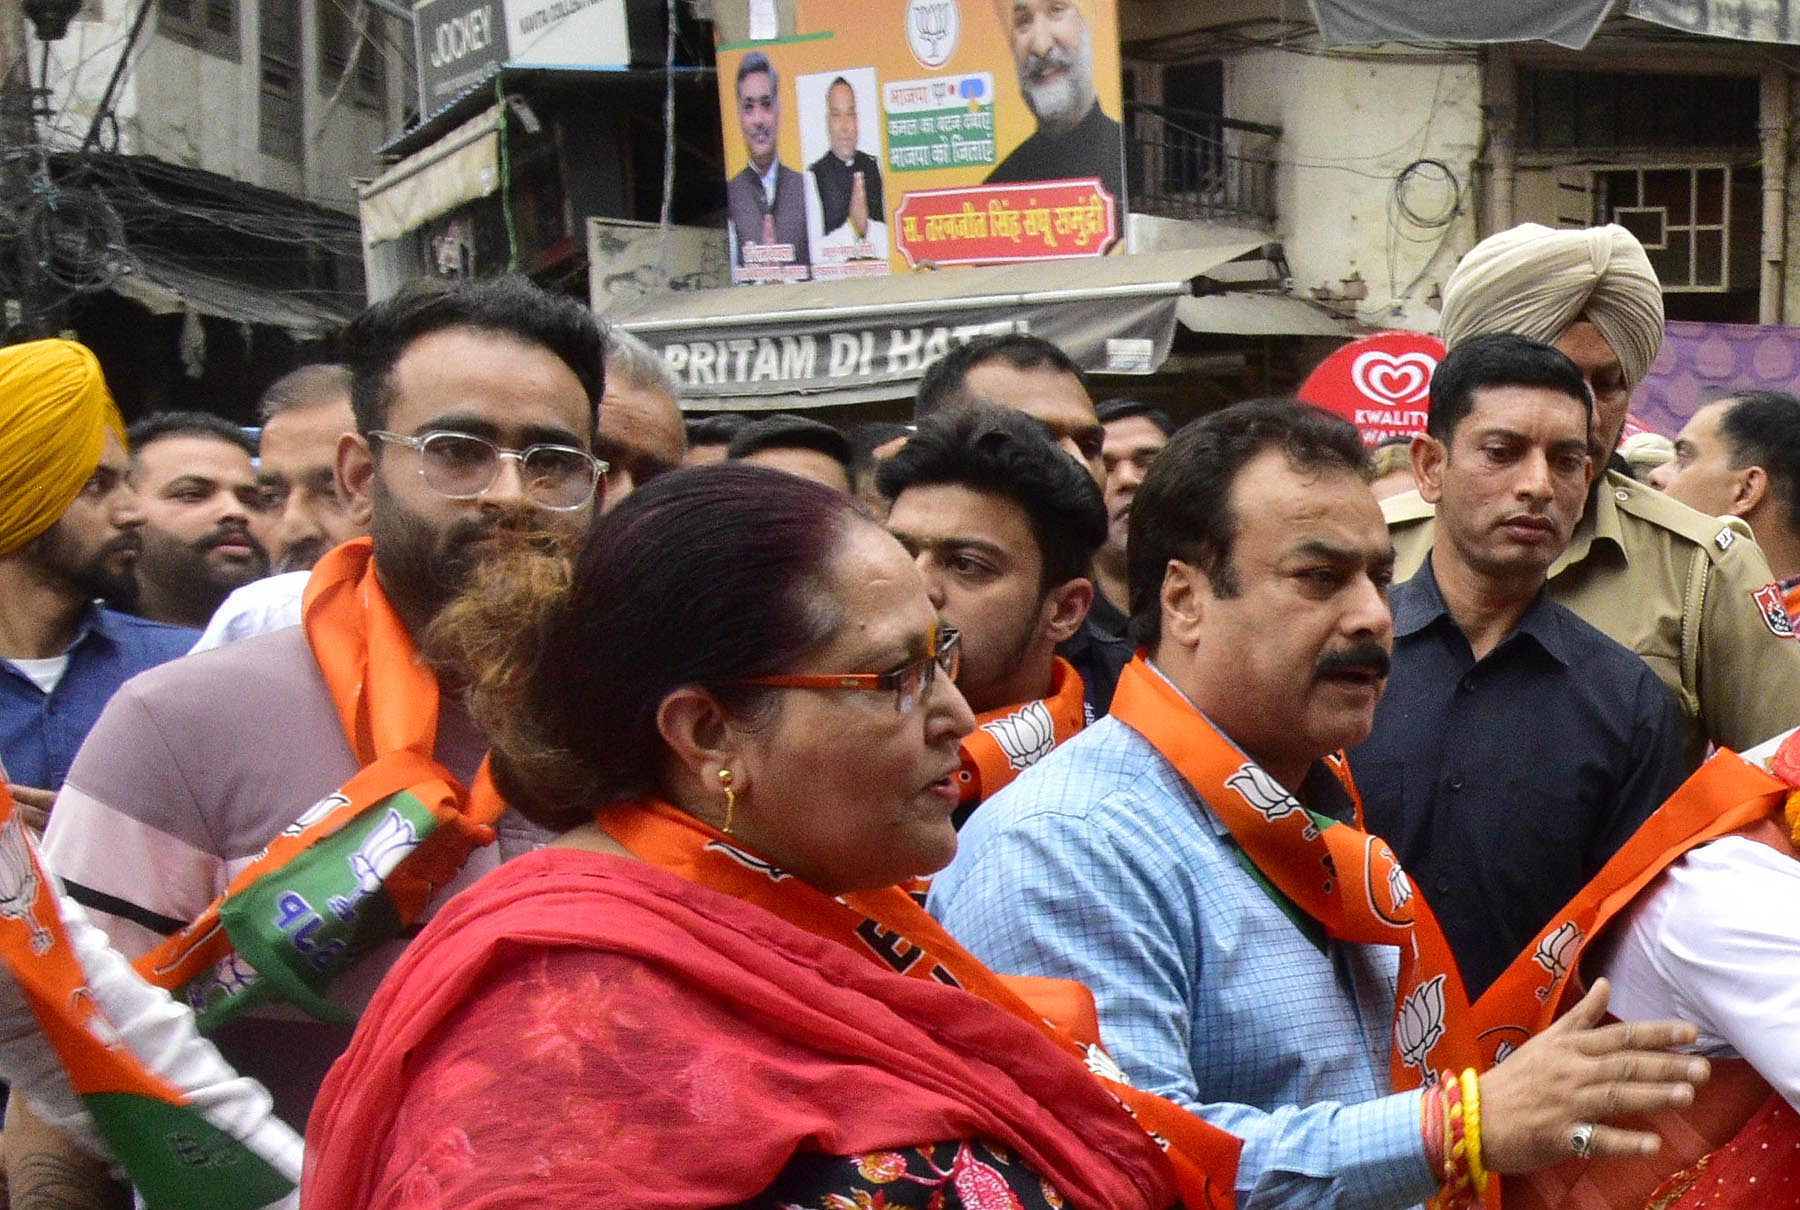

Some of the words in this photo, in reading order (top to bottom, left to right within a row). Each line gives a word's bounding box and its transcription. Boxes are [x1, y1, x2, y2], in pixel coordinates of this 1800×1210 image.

[430, 5, 492, 68] JOCKEY
[664, 336, 816, 385] PRITAM
[829, 330, 876, 379] DI
[1355, 409, 1428, 426] KWALITY
